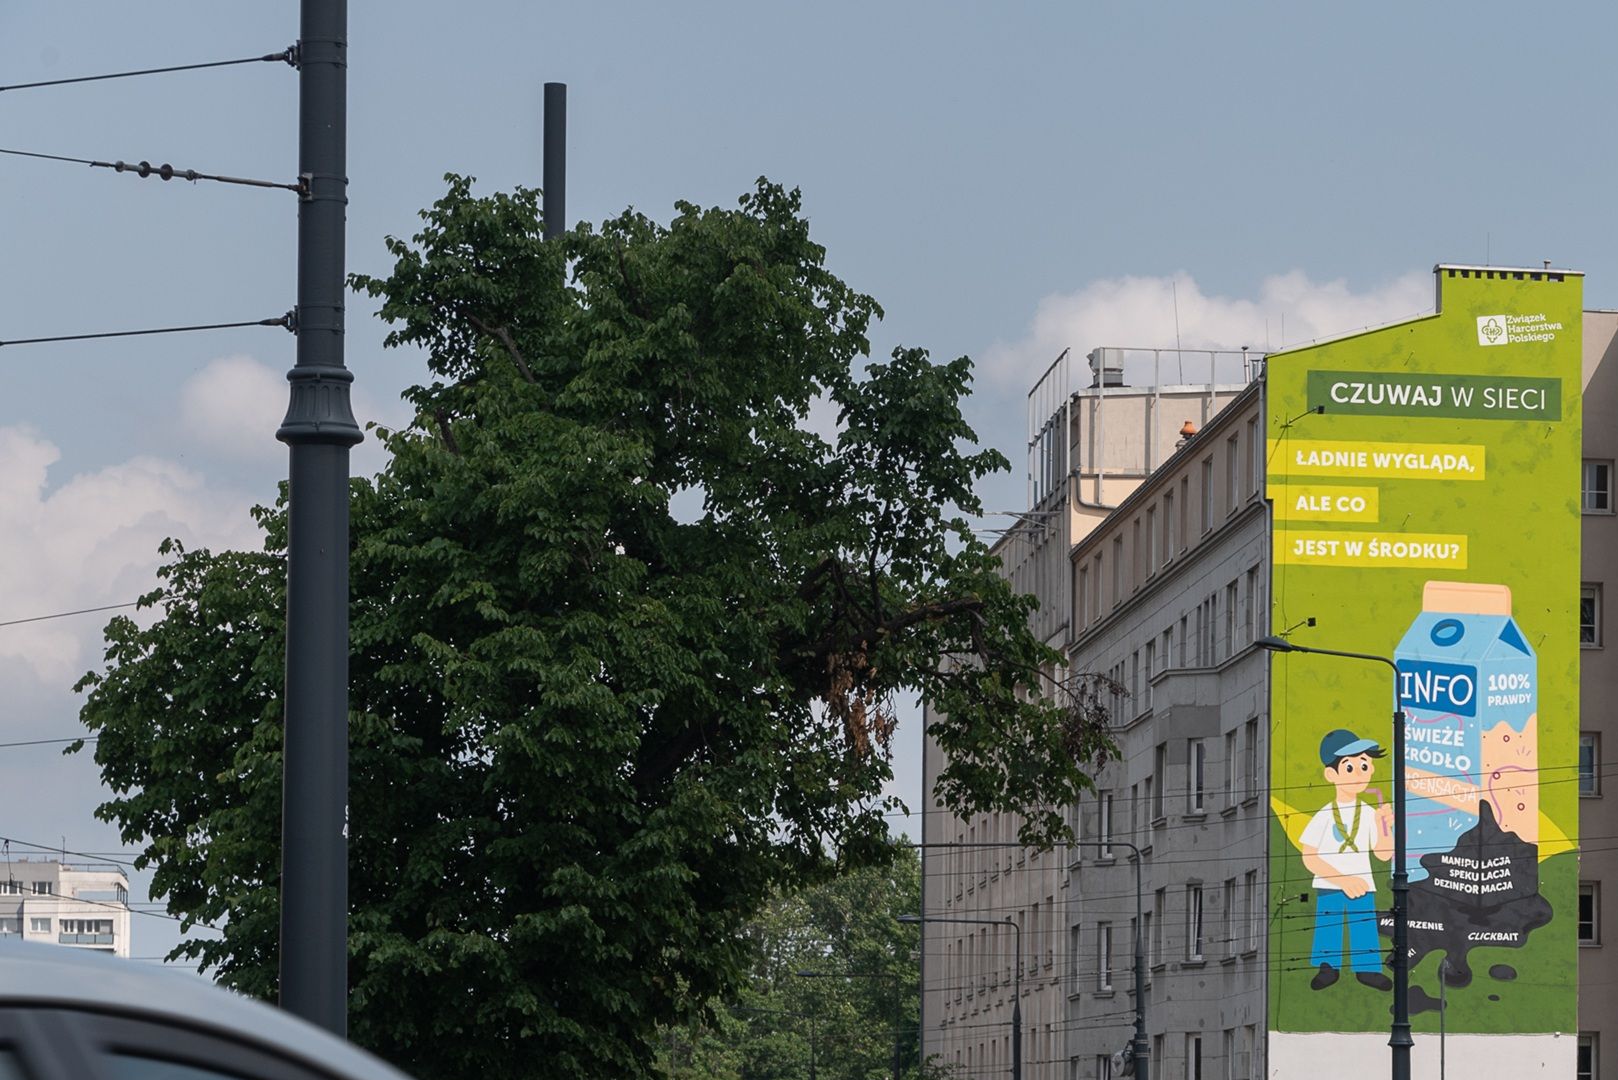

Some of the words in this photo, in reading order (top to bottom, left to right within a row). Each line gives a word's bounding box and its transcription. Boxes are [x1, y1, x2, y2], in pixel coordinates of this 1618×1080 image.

[1506, 313, 1546, 324] Związek
[1508, 322, 1563, 334] Harcerstwa
[1508, 332, 1555, 343] Polskiego
[1330, 382, 1443, 407] CZUWAJ
[1450, 386, 1474, 408] W
[1482, 387, 1546, 410] SIECI
[1296, 450, 1368, 468] ŁADNIE
[1373, 452, 1476, 474] WYGLĄDA,
[1295, 496, 1331, 512] ALE
[1336, 496, 1366, 512] CO
[1294, 539, 1340, 556] JEST
[1344, 541, 1363, 557] W
[1368, 538, 1460, 560] ŚRODKU?
[1401, 671, 1474, 706] INFO
[1487, 673, 1531, 692] 100%
[1487, 693, 1532, 707] PRAWDY
[1404, 722, 1465, 747] ŚWIEŻE
[1468, 932, 1519, 942] CLICKBAIT
